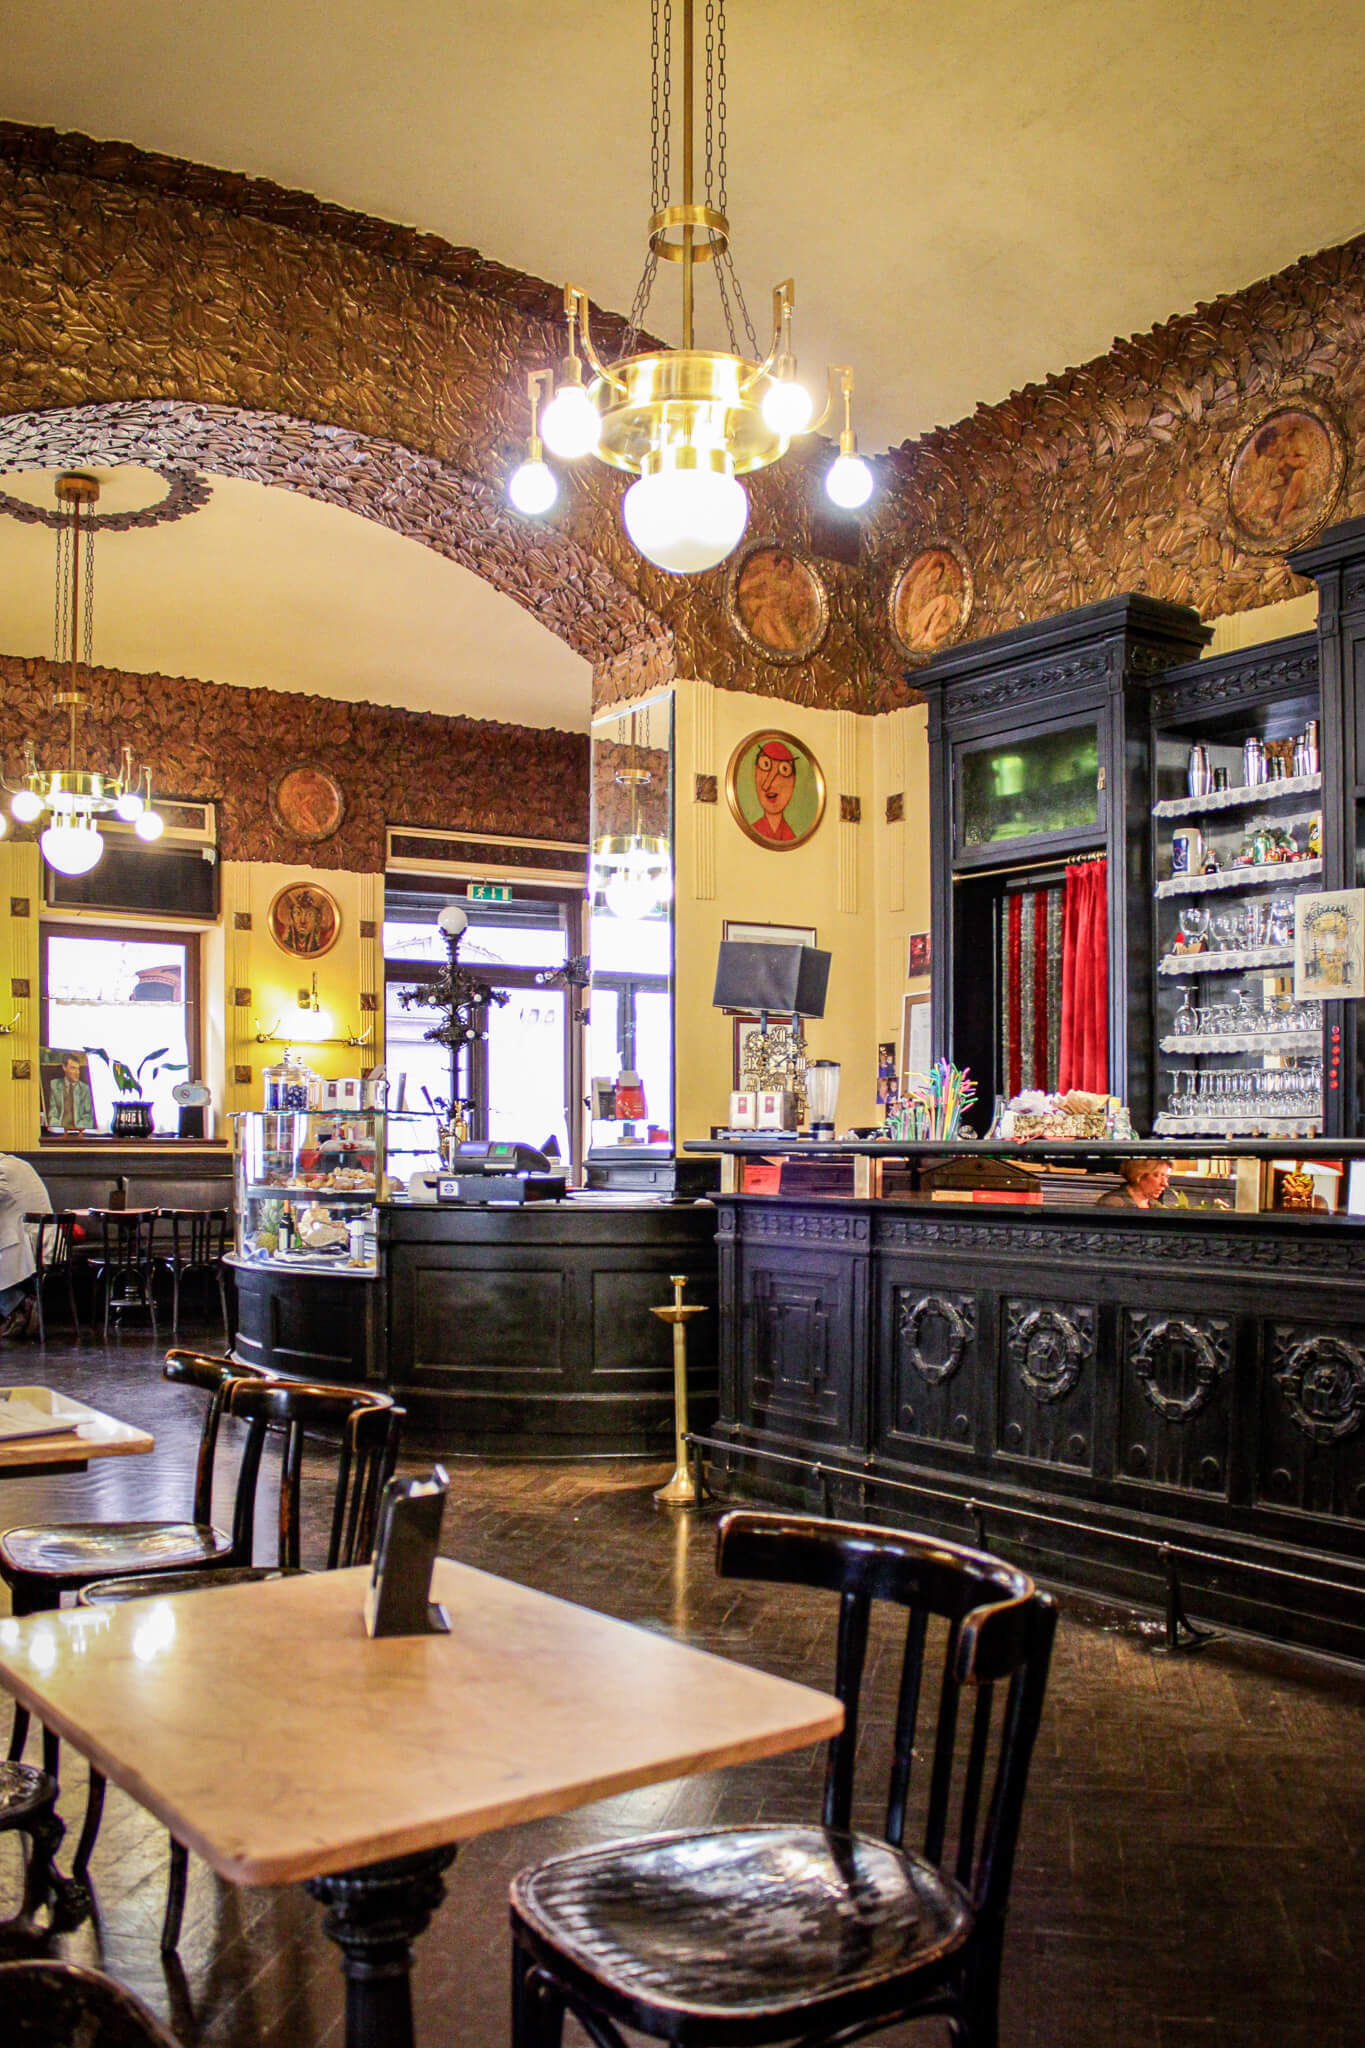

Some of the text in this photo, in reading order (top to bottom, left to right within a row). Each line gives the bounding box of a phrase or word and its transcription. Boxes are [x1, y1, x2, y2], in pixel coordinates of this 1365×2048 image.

[773, 1030, 786, 1042] XII
[748, 1057, 759, 1070] IX
[798, 1057, 807, 1070] III
